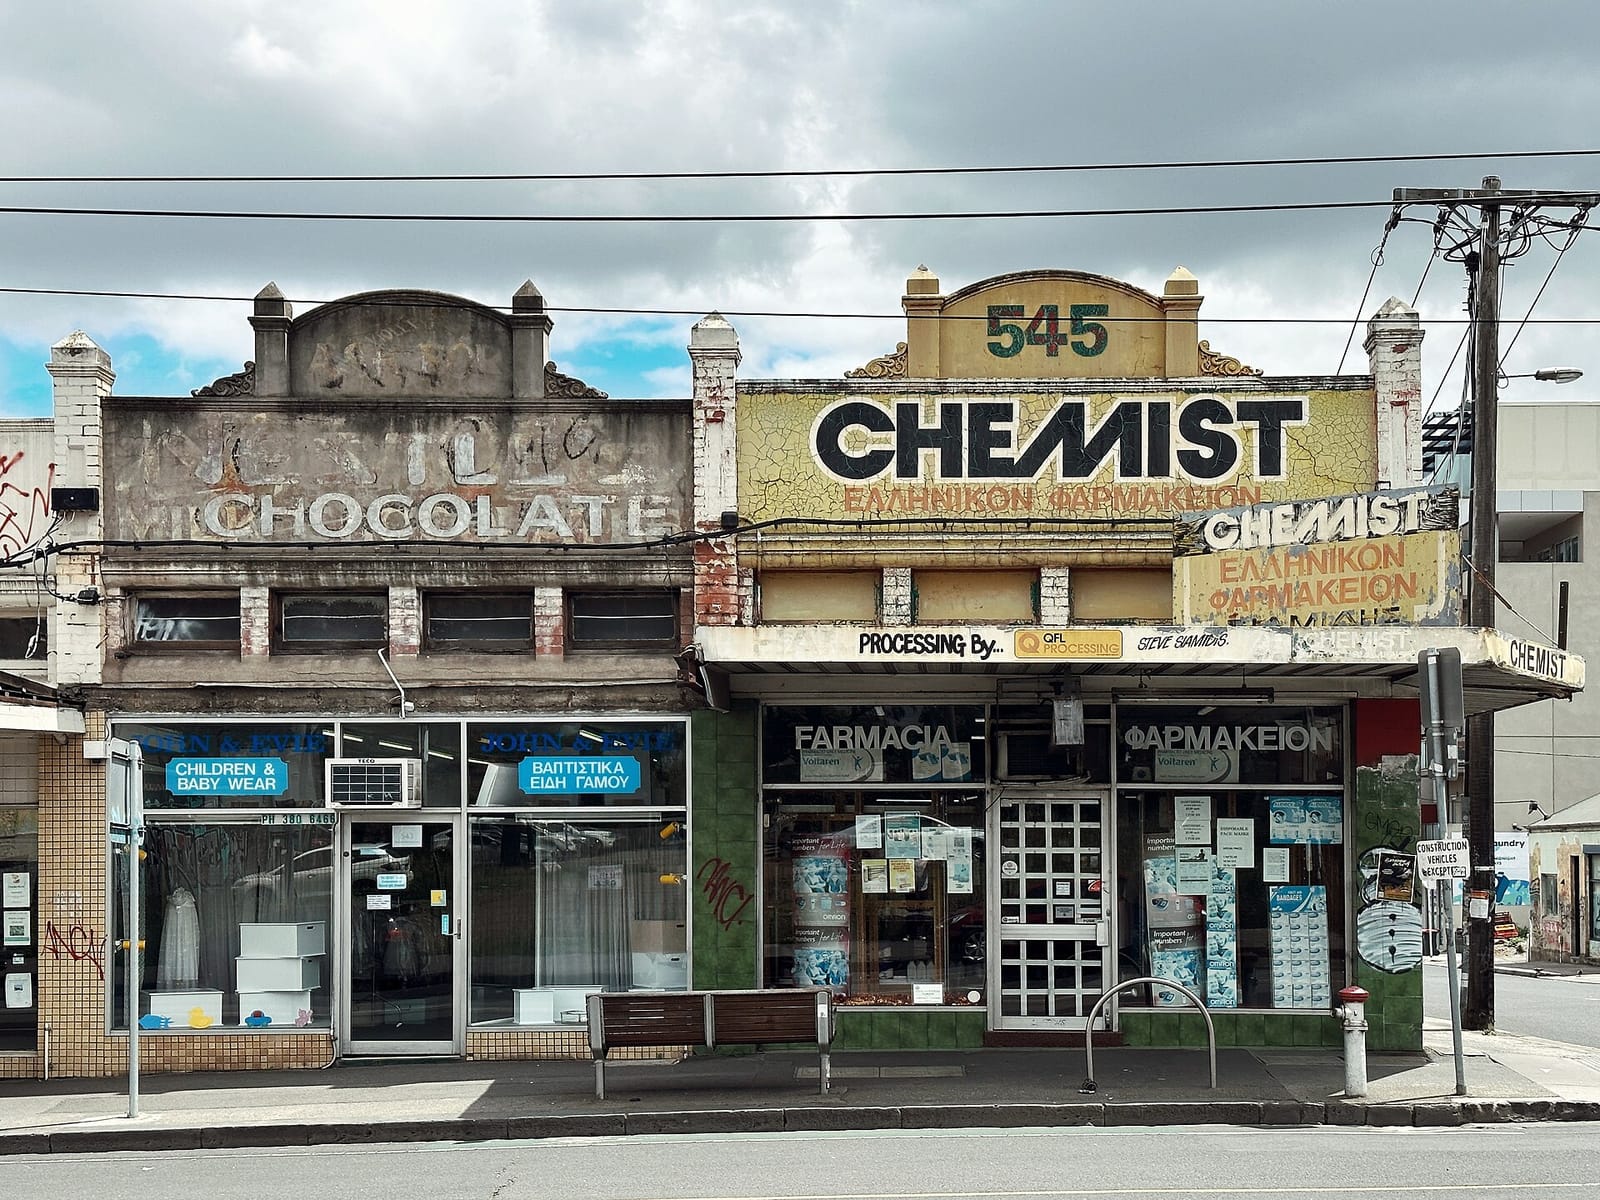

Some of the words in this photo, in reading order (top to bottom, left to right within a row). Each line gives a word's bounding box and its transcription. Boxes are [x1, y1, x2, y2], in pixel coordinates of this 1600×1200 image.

[986, 304, 1109, 358] 545
[813, 397, 1304, 481] CHEMIST
[843, 486, 1033, 512] ΕΛΛΗΝΙΚΟΝ
[1050, 485, 1262, 511] ΦΑΡΜΑΚΕΙΟΝ
[204, 492, 672, 538] CHOCOLATE
[1203, 489, 1430, 551] CHEMIST
[1219, 541, 1405, 584] ΕΛΛΗΝΙΚΟΝ
[1208, 571, 1417, 614] ΦΑΡΜΑΚΕΙΟΝ
[859, 632, 966, 656] PROCESSING
[1043, 633, 1066, 644] QFL
[1138, 636, 1175, 650] STEVE
[1043, 643, 1120, 654] PROCESSING
[1510, 639, 1567, 679] CHEMIST
[220, 735, 241, 753] &
[573, 735, 593, 752] &
[795, 724, 953, 751] FARMACIA
[1124, 725, 1333, 751] ΦΑΡΜΑΚΕΙΟΝ
[532, 761, 625, 775] ΒΑΠΤΙΣΤΙΚΑ
[802, 756, 840, 766] Voltaren
[1158, 756, 1196, 766] Voltaren
[175, 762, 256, 776] CHILDREN
[263, 762, 275, 776] &
[177, 777, 220, 790] BABY
[228, 777, 276, 790] WEAR
[530, 775, 566, 789] ΕΙΔΗ
[576, 775, 630, 789] ΓΑΜΟΥ
[262, 814, 275, 824] PH
[1417, 840, 1467, 853] CONSTRUCTION
[1427, 853, 1457, 865] VEHICLES
[1427, 866, 1451, 877] EXCEPT
[1153, 929, 1186, 938] Important
